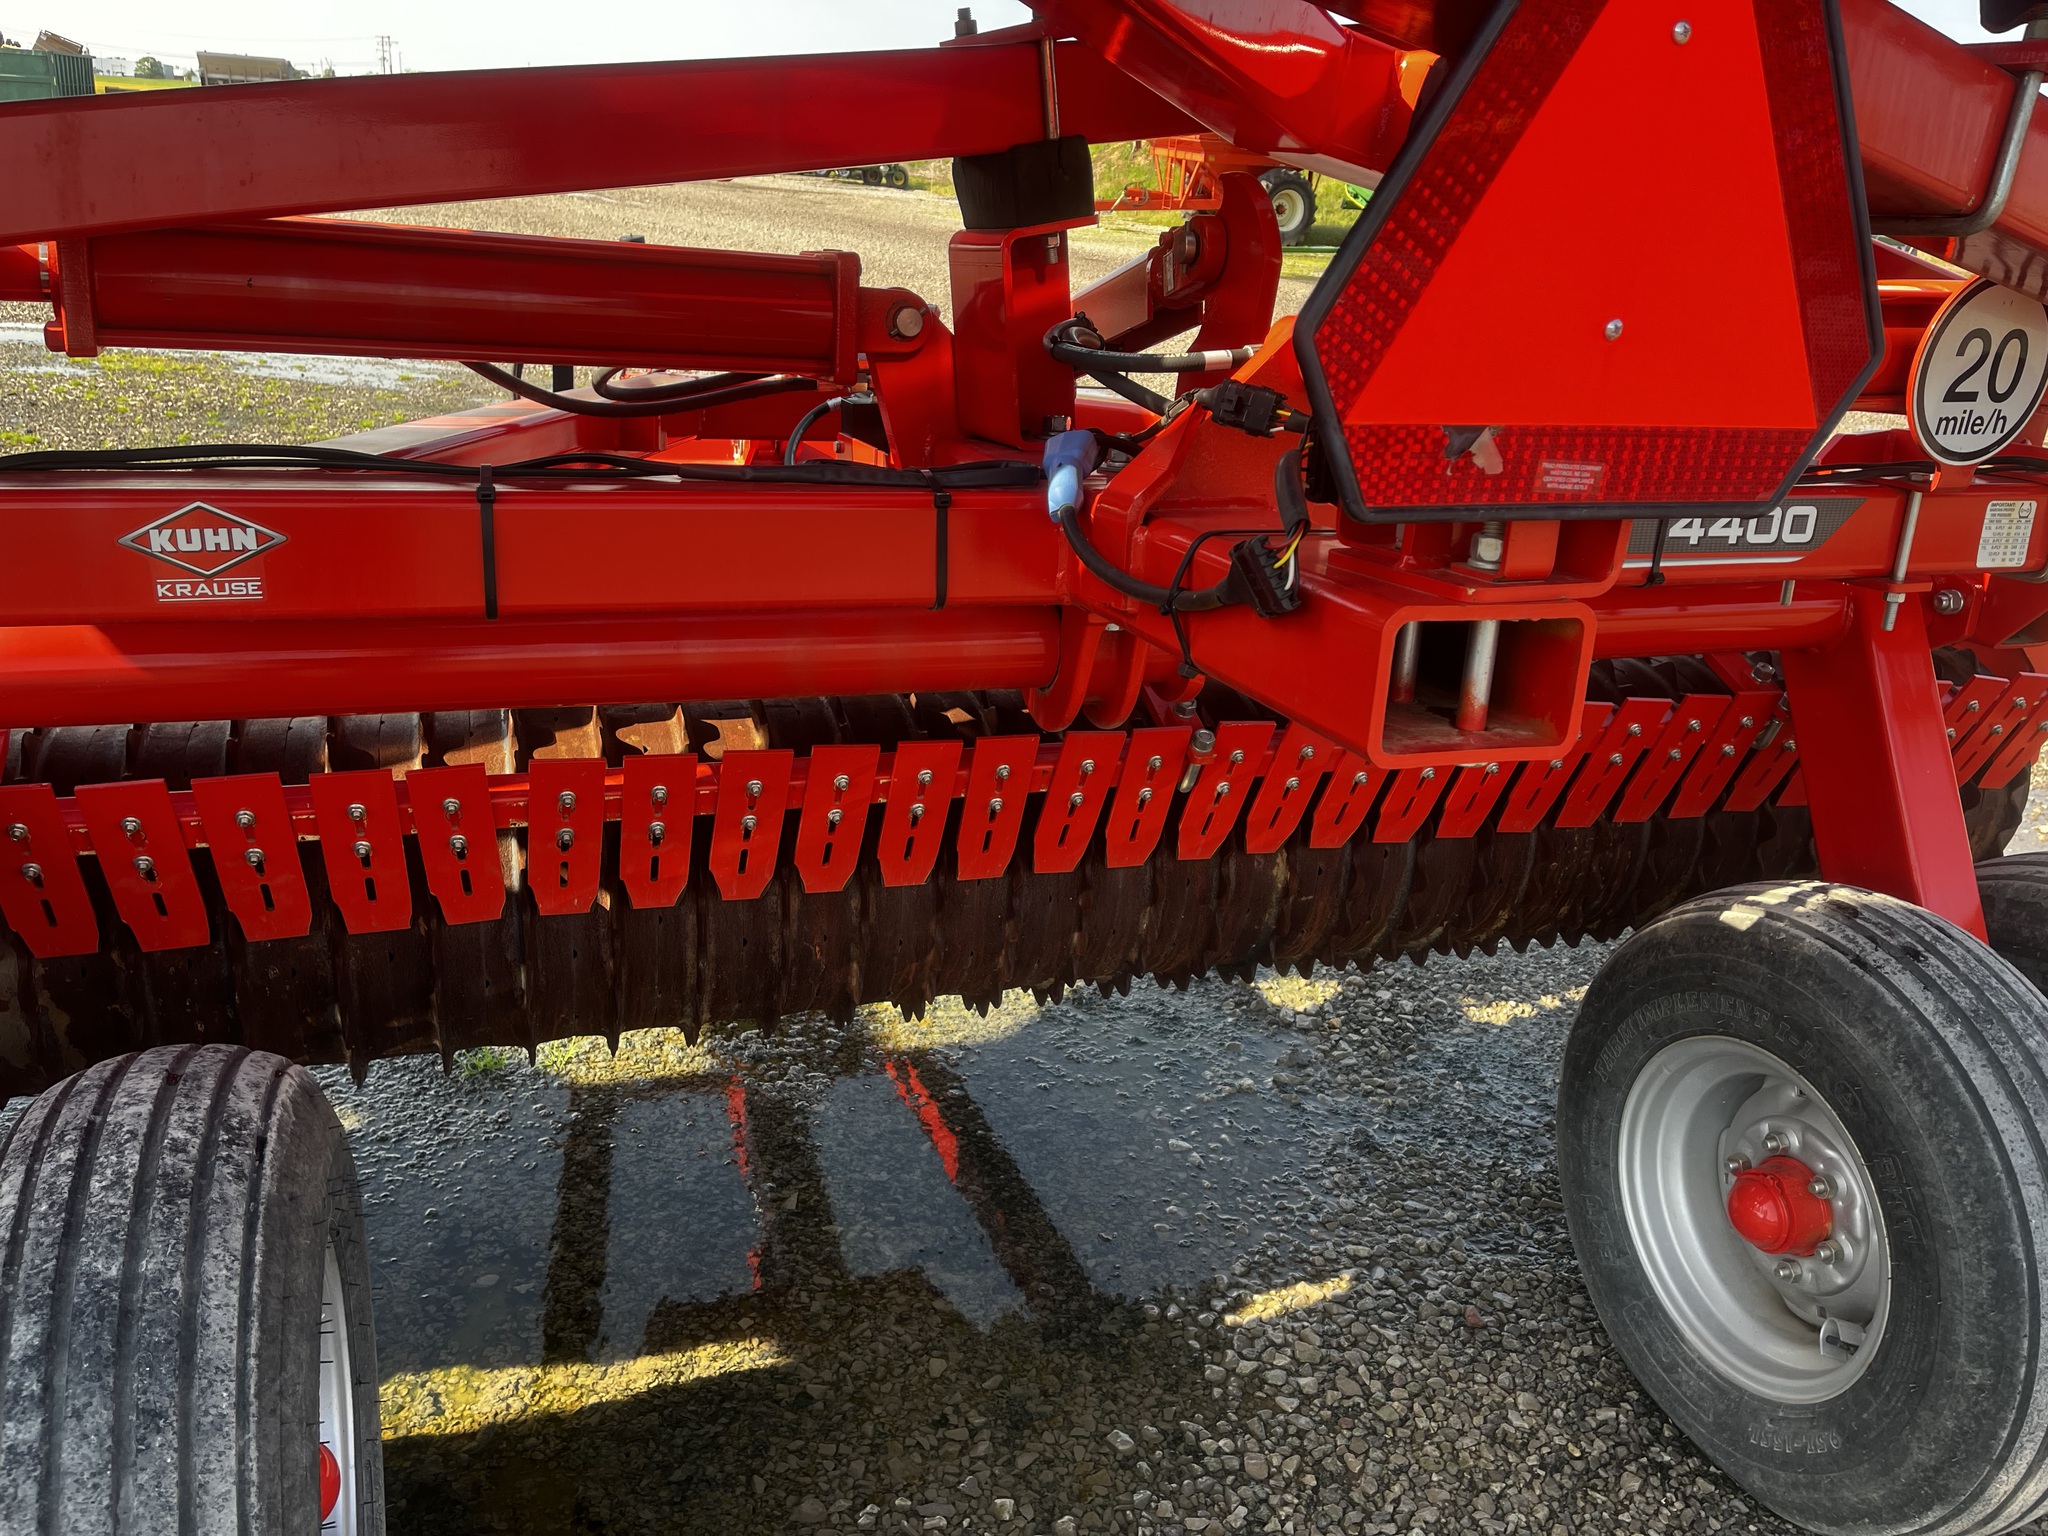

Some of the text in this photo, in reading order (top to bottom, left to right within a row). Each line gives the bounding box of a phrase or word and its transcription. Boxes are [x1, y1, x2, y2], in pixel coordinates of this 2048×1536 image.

[1942, 327, 2029, 404] 20
[1934, 408, 2008, 436] mile/h
[149, 527, 258, 552] KUHN
[1668, 505, 1818, 545] 4400
[156, 582, 263, 597] KRAUSE
[1593, 1018, 1635, 1083] FARM
[1634, 991, 1770, 1031] IMPLEMENT
